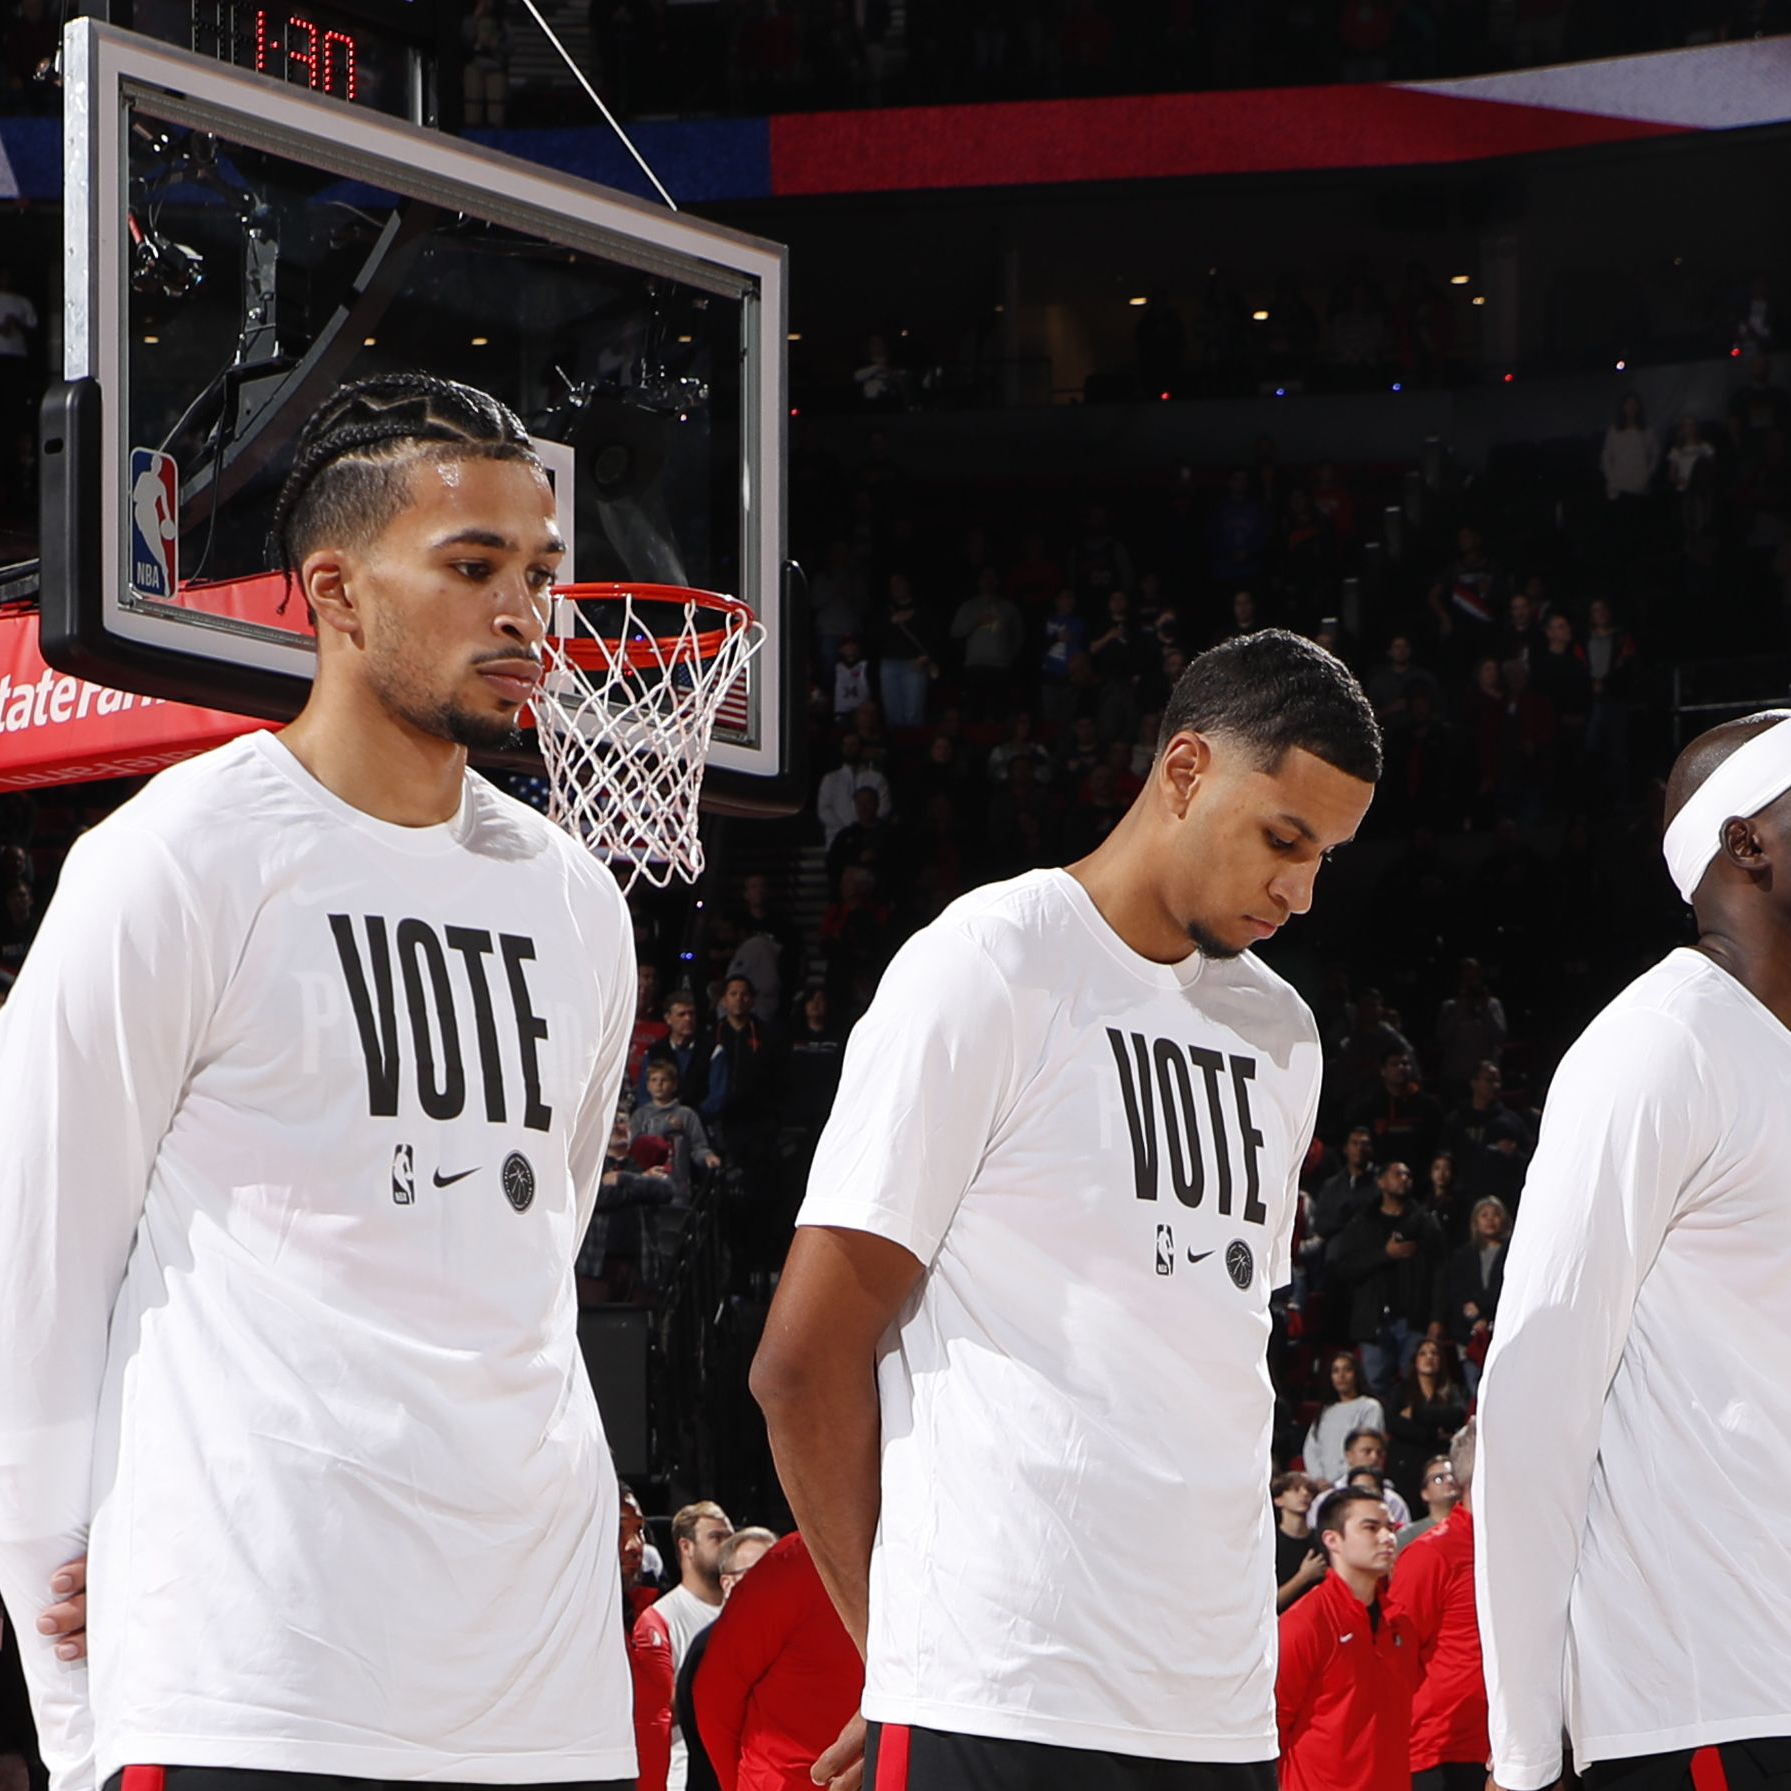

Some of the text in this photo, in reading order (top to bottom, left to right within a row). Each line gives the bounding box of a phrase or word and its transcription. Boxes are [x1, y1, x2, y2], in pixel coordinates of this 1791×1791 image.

[137, 562, 160, 588] NBA
[327, 913, 552, 1133] VOTE
[1105, 1026, 1267, 1226] VOTE
